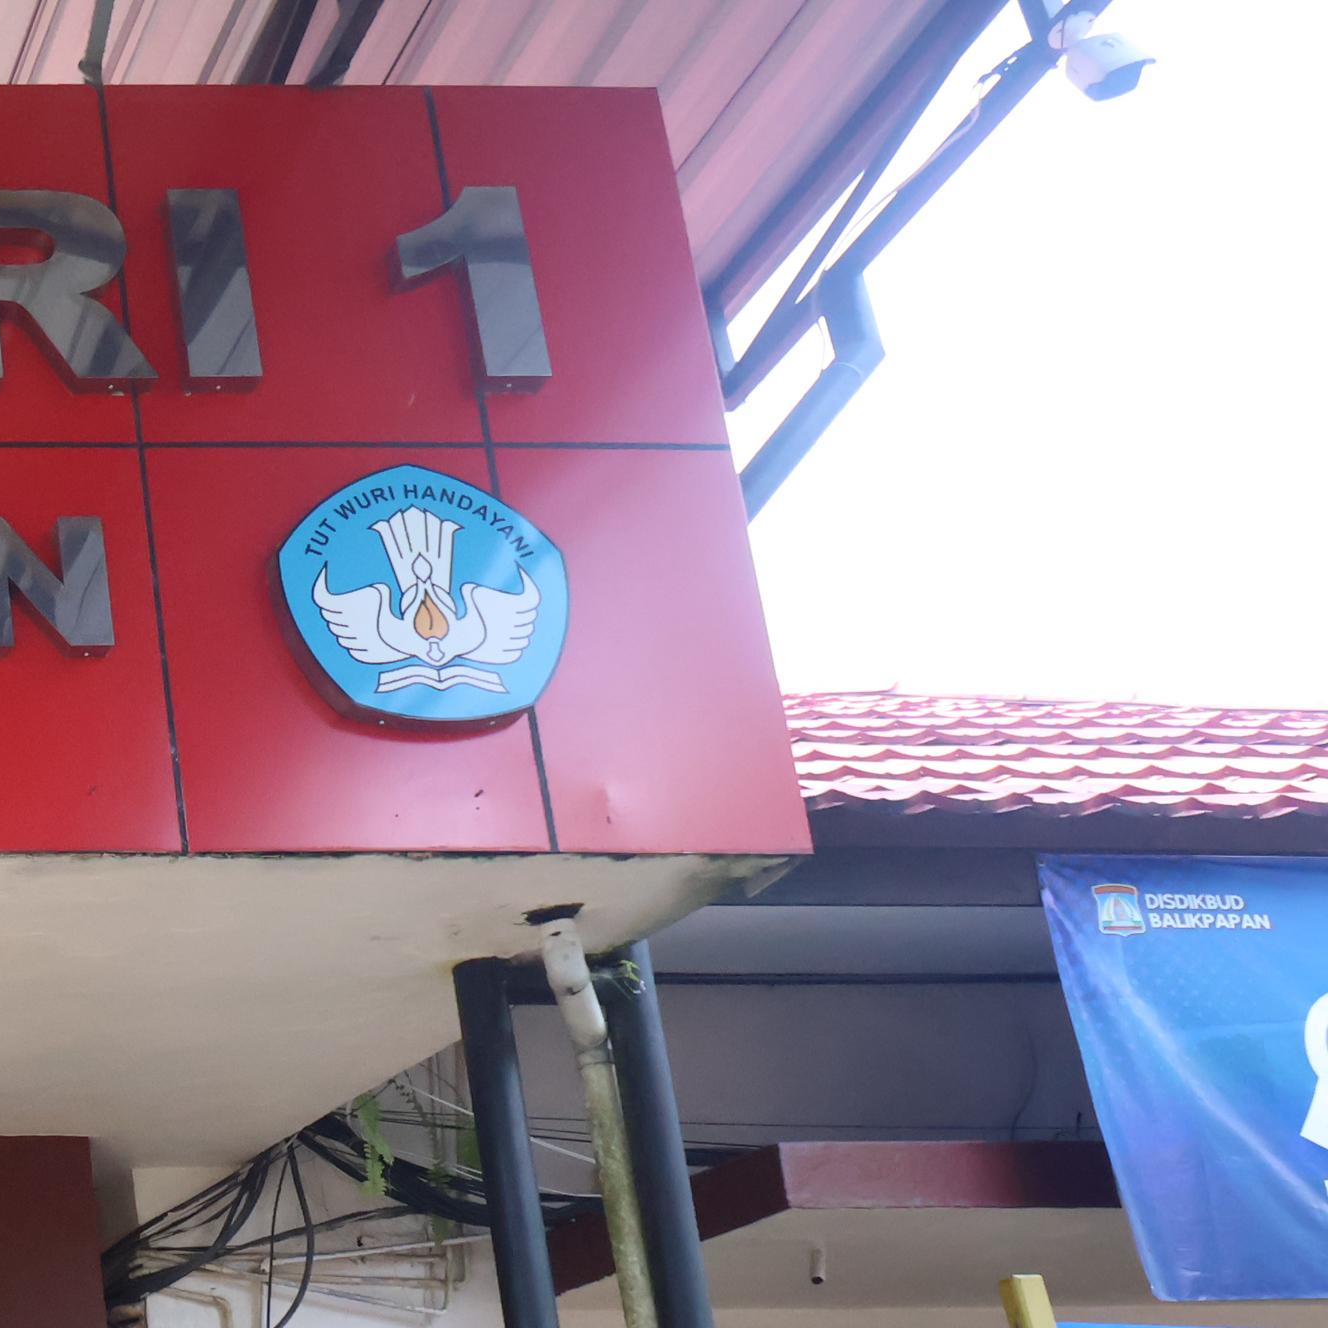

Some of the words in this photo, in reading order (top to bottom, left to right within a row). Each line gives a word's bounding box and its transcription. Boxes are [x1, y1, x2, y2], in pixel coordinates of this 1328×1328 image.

[390, 186, 552, 393] 1
[305, 518, 336, 556] TUT
[334, 486, 395, 520] WURI
[404, 484, 534, 560] HANDAYANI
[1145, 893, 1244, 911] DISDIKBUD
[1148, 911, 1271, 930] BALIKPAPAN
